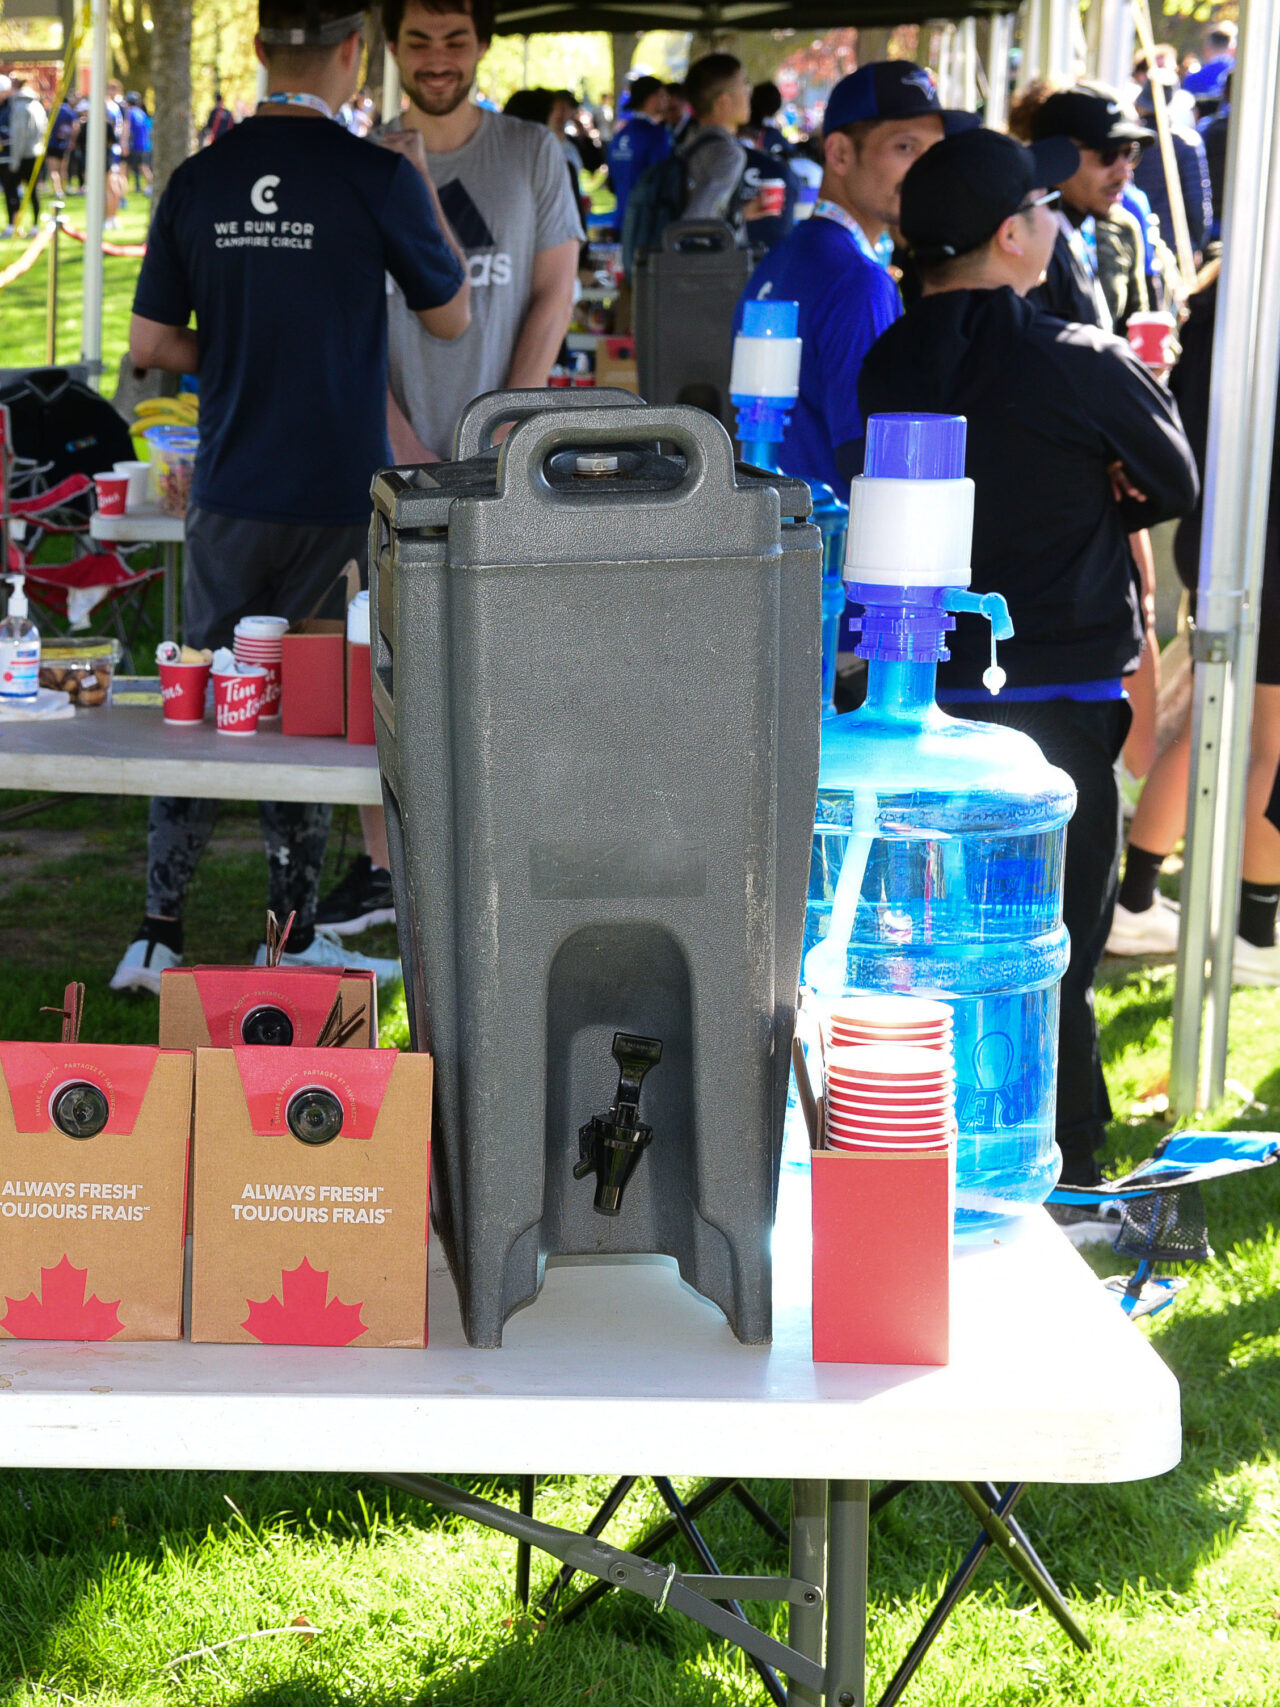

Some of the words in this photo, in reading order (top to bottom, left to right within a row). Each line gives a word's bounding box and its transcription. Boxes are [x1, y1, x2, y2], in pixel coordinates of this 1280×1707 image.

[214, 221, 239, 235] WE
[244, 220, 276, 234] RUN
[281, 221, 315, 236] FOR
[215, 236, 269, 248] CAMPFIRE
[271, 236, 312, 249] CIRCLE
[467, 253, 512, 287] as
[221, 678, 257, 703] Tim
[64, 1062, 99, 1073] PARTAGEZ
[303, 1069, 338, 1080] PARTAGEZ
[1, 1180, 76, 1199] ALWAYS
[241, 1183, 317, 1202] ALWAYS
[231, 1204, 330, 1223] TOUJOURS
